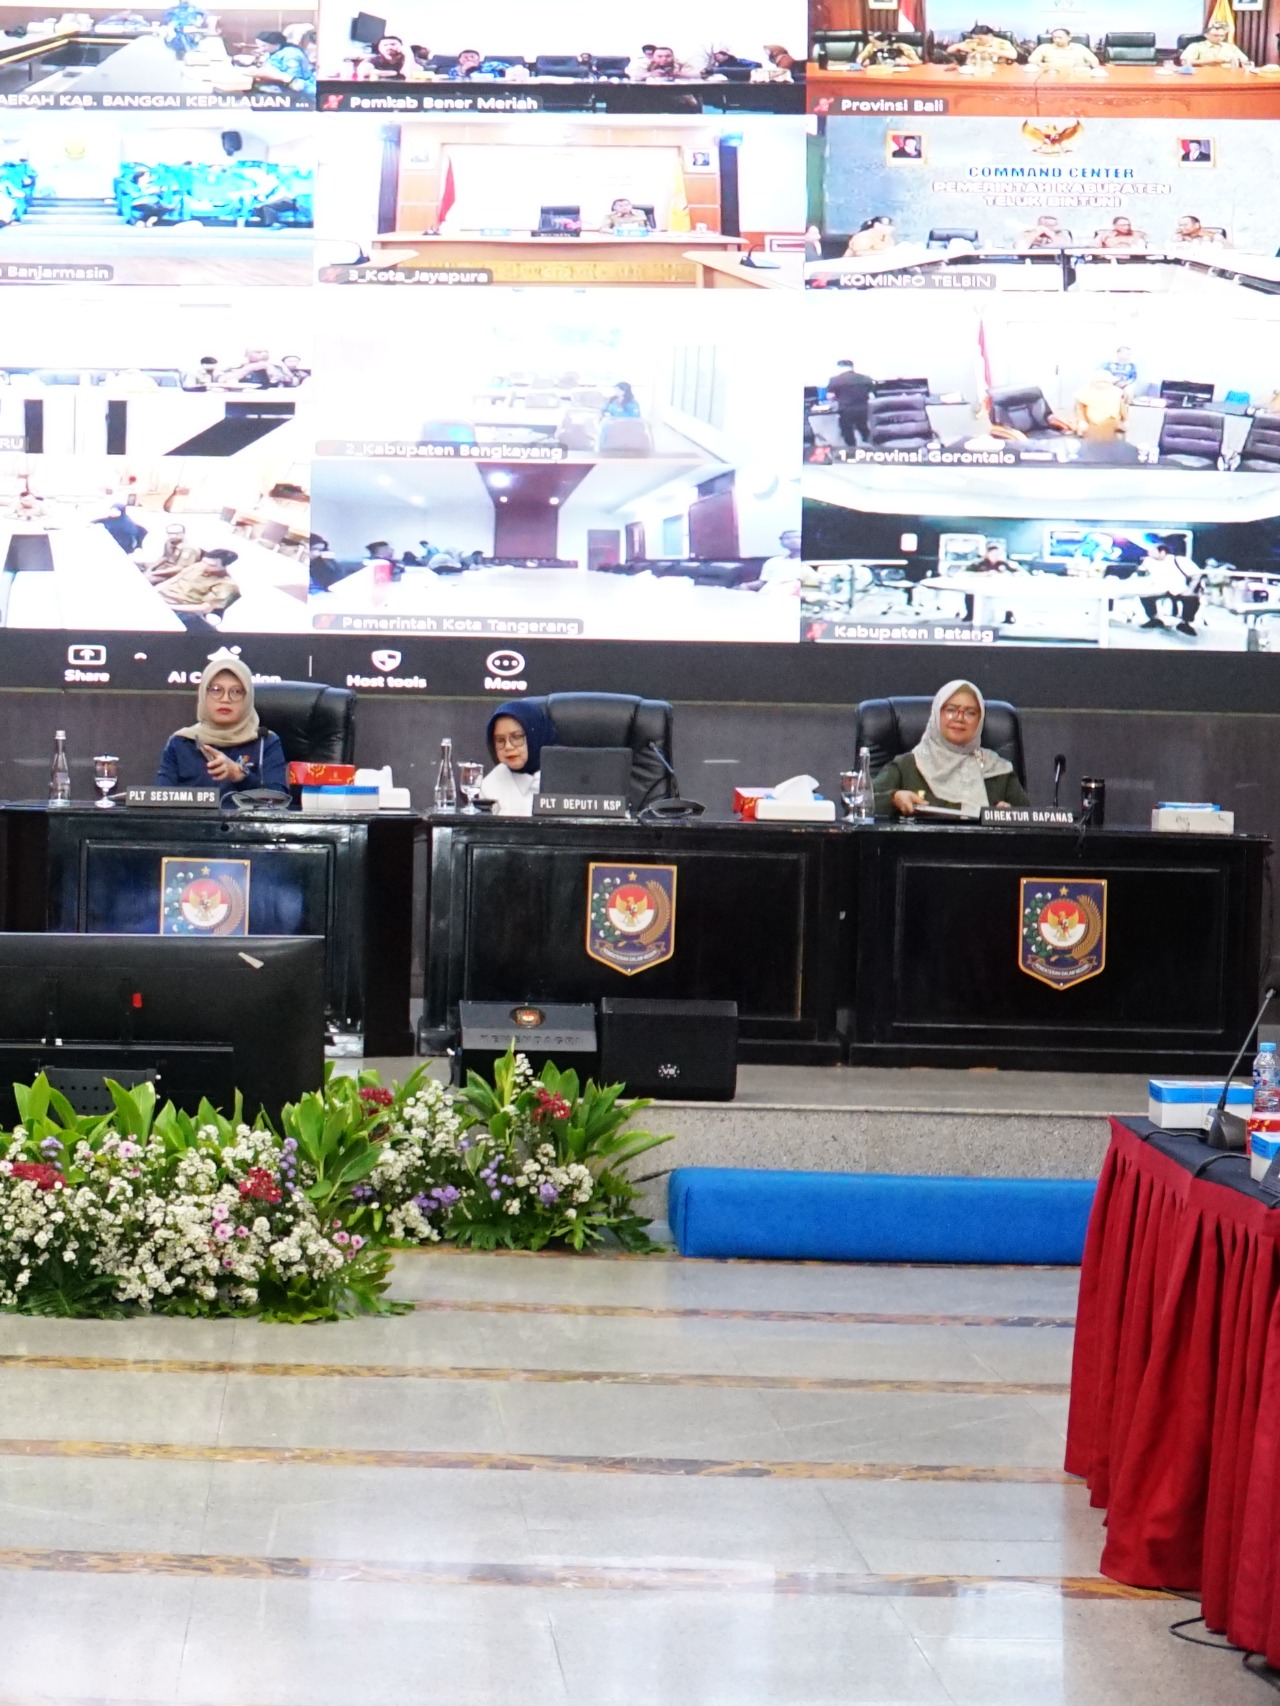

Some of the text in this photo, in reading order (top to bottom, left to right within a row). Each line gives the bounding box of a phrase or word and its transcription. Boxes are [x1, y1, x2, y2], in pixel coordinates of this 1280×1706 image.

[60, 95, 98, 107] KAB.
[103, 95, 181, 107] BANGGAI
[186, 96, 291, 108] KEPULAUAN
[349, 96, 538, 110] Pemkab Bener Meriah
[840, 99, 944, 112] Provinsi Bali
[968, 167, 1135, 179] COMMAND CENTER
[932, 182, 1172, 196] PEMERINTAH KABUPATEN
[985, 195, 1122, 208] TELUK BINTUNI
[7, 266, 110, 281] Banjarmasin
[839, 273, 991, 289] KOMINFO TELBIN
[459, 445, 563, 460] Bengkayang
[928, 451, 1016, 464] Gorontalo
[342, 616, 579, 635] Pemerintah Kota Tangerang
[833, 625, 995, 643] Kabupaten Batang
[64, 669, 110, 682] Share
[168, 671, 187, 684] AI
[346, 674, 428, 688] Host tools
[484, 677, 528, 690] More
[129, 790, 216, 802] PLT SESTAMA BPS
[539, 798, 622, 811] PLT DEPUTI KSP
[984, 810, 1074, 823] DIREKTUR BAPANAS
